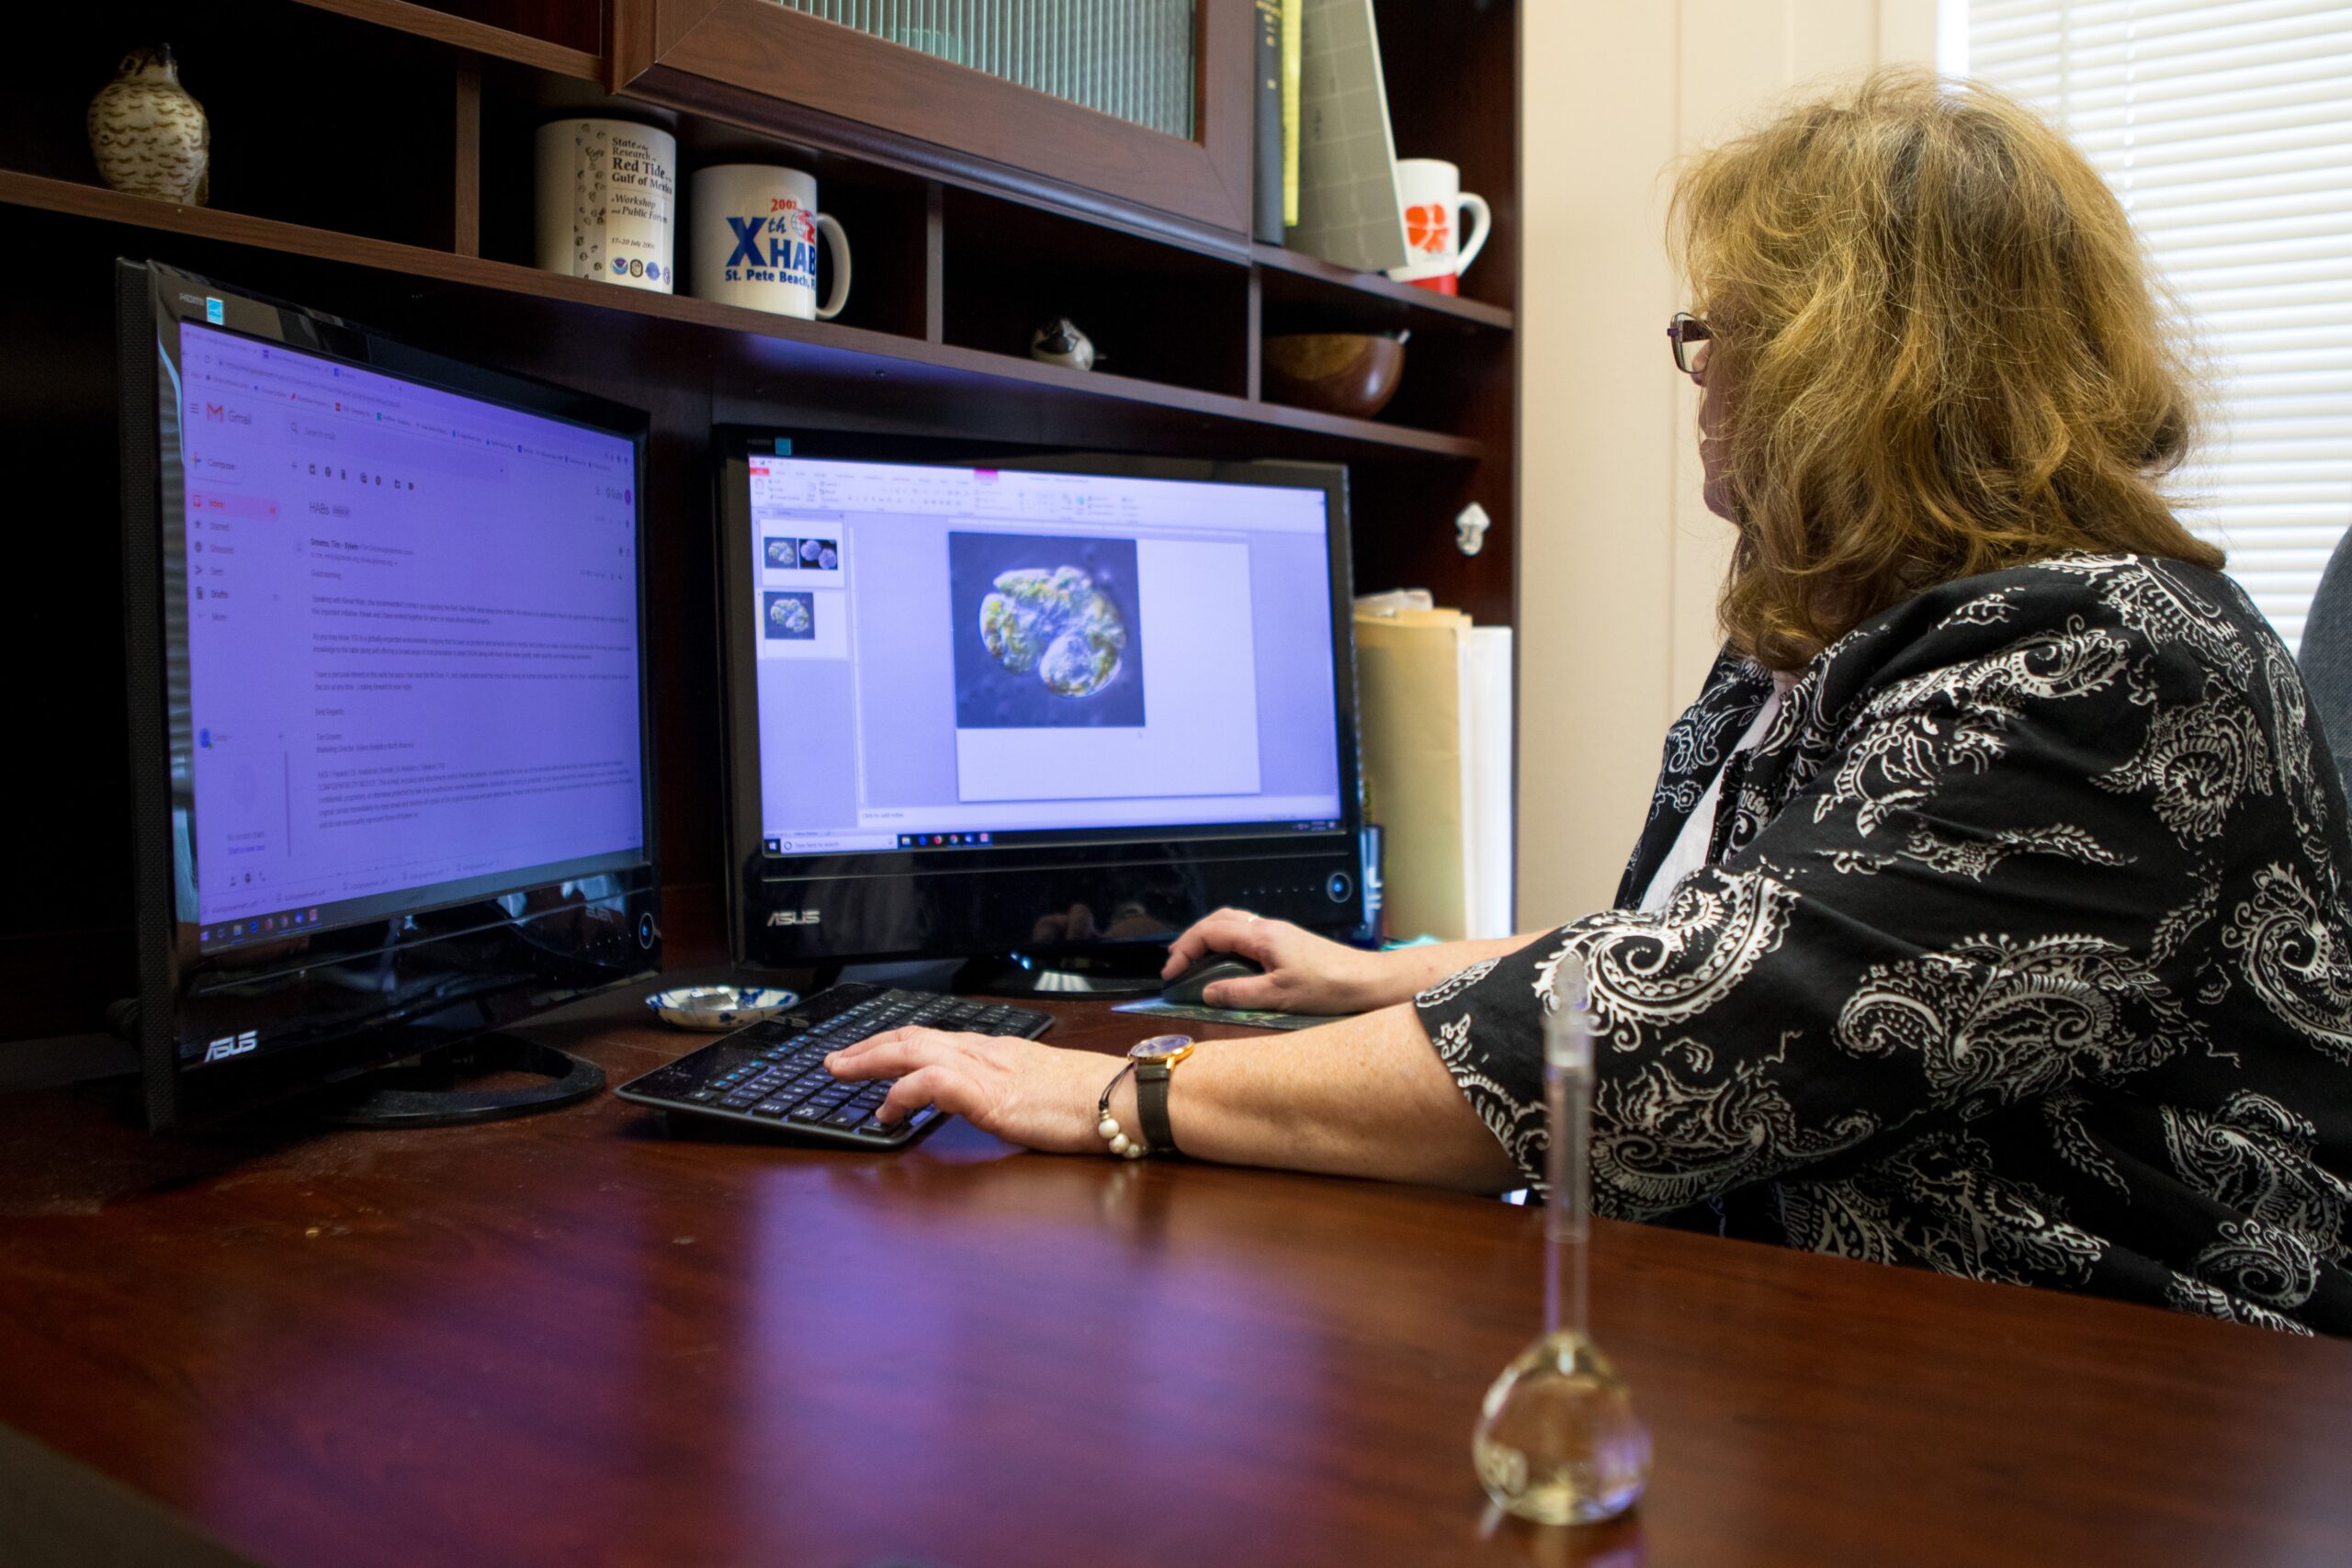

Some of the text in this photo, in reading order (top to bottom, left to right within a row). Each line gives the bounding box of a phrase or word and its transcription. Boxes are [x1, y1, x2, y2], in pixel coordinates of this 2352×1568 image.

[612, 137, 637, 148] State
[612, 147, 650, 161] Research
[612, 157, 639, 173] Red
[642, 162, 665, 179] Tide
[612, 172, 636, 184] Gulf
[638, 176, 649, 186] of
[615, 194, 656, 209] Workshop
[771, 197, 797, 212] 2002
[622, 206, 648, 218] Public
[725, 269, 741, 282] St.
[746, 269, 775, 282] Pete
[229, 410, 252, 425] Gmail
[207, 458, 235, 470] Compose
[309, 500, 330, 514] HABs
[767, 909, 821, 927] ASUS
[204, 1030, 257, 1063] ASUS
